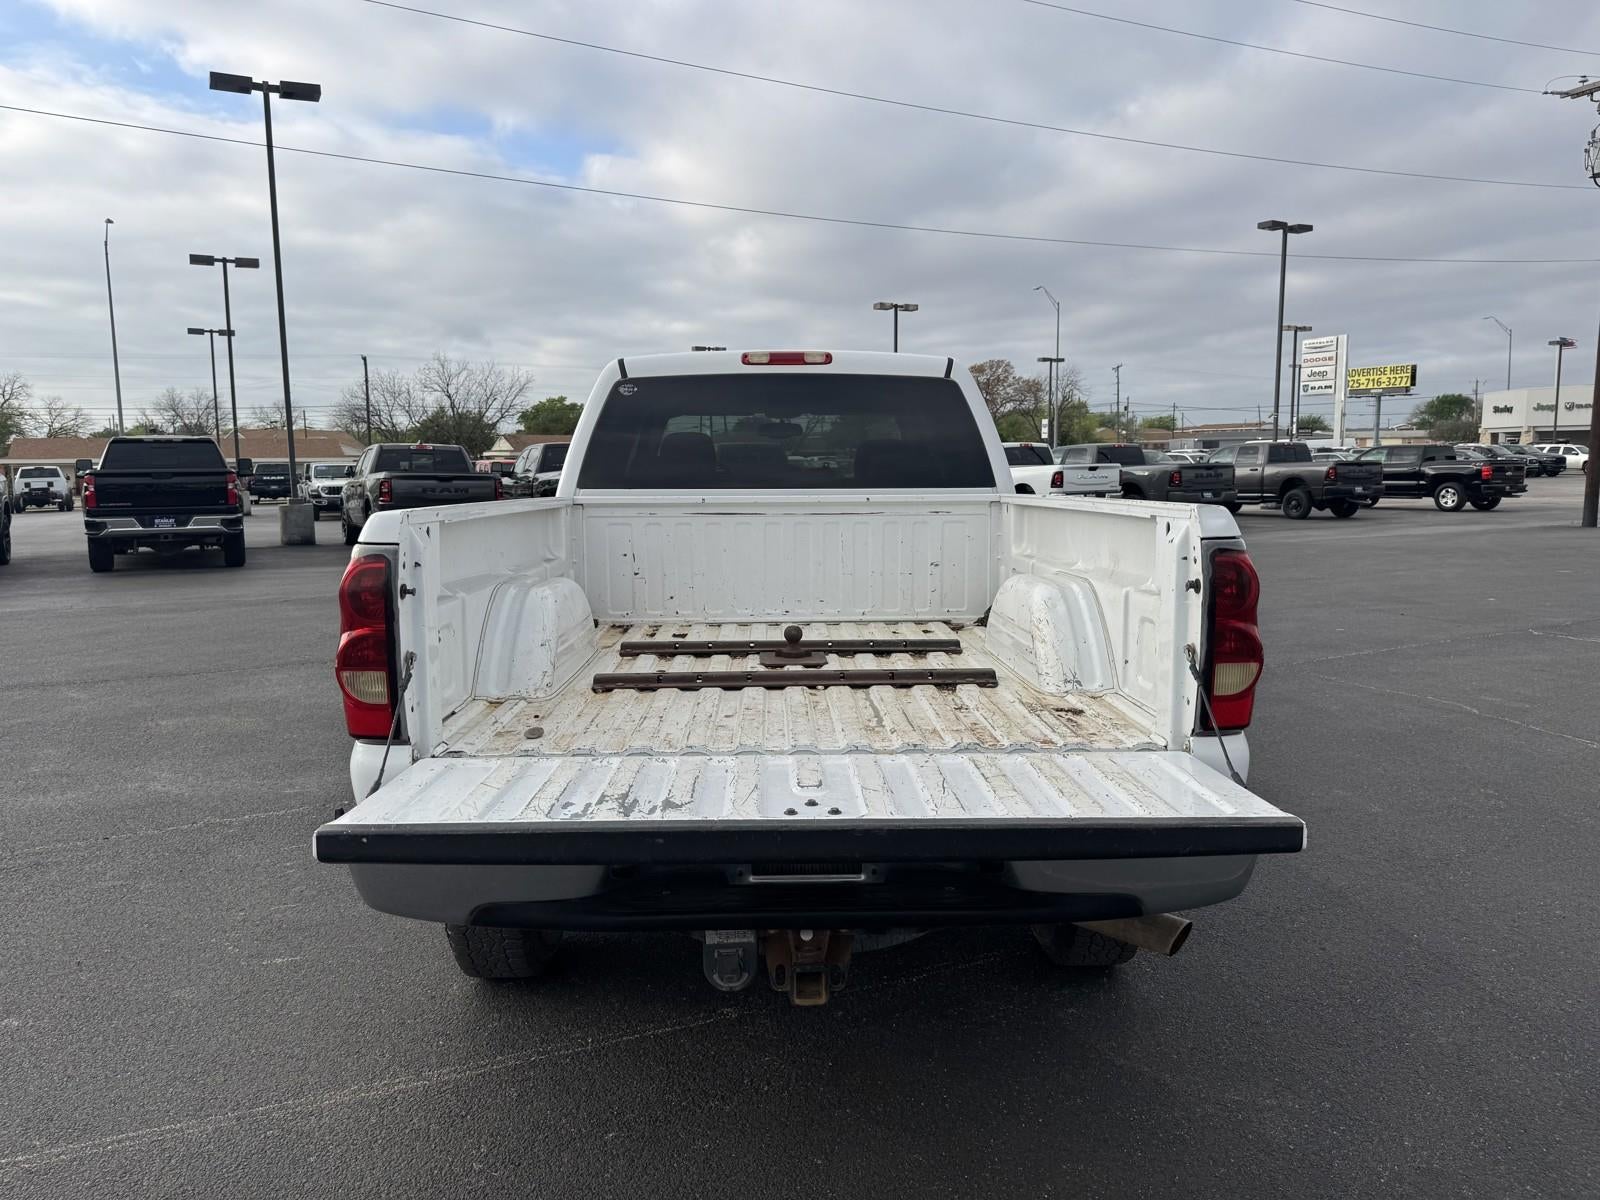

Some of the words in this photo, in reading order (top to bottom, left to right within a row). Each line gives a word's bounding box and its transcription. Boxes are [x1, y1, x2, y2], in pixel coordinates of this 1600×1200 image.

[1307, 369, 1328, 378] Jeep
[1390, 365, 1410, 375] HERE
[421, 487, 470, 495] RAM
